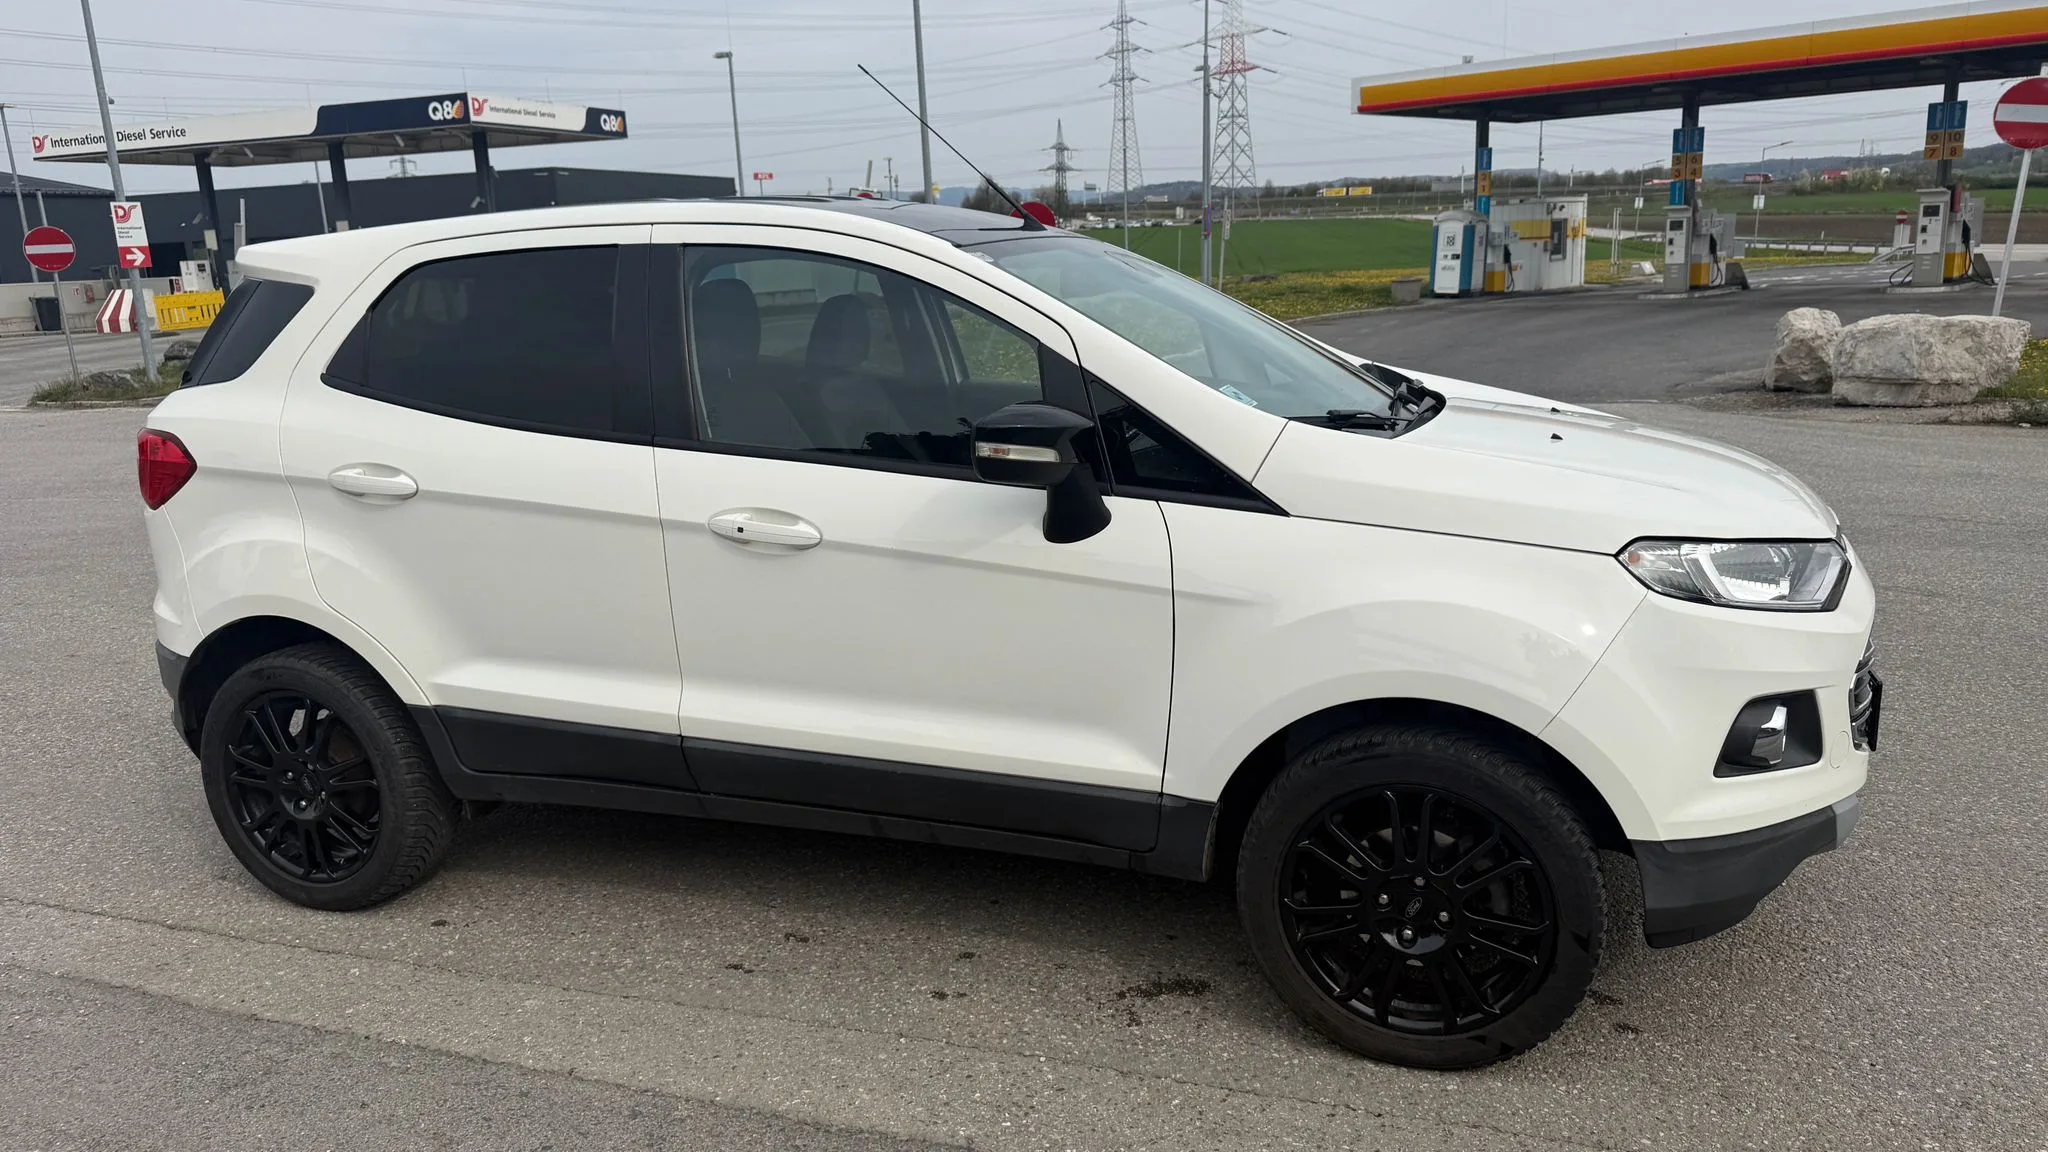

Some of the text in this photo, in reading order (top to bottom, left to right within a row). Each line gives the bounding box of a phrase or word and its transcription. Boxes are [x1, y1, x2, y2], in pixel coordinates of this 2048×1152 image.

[428, 101, 454, 121] Q8
[489, 105, 556, 119] International Diesel Service
[600, 113, 617, 132] Q8
[50, 126, 187, 149] Internation Diesel Service
